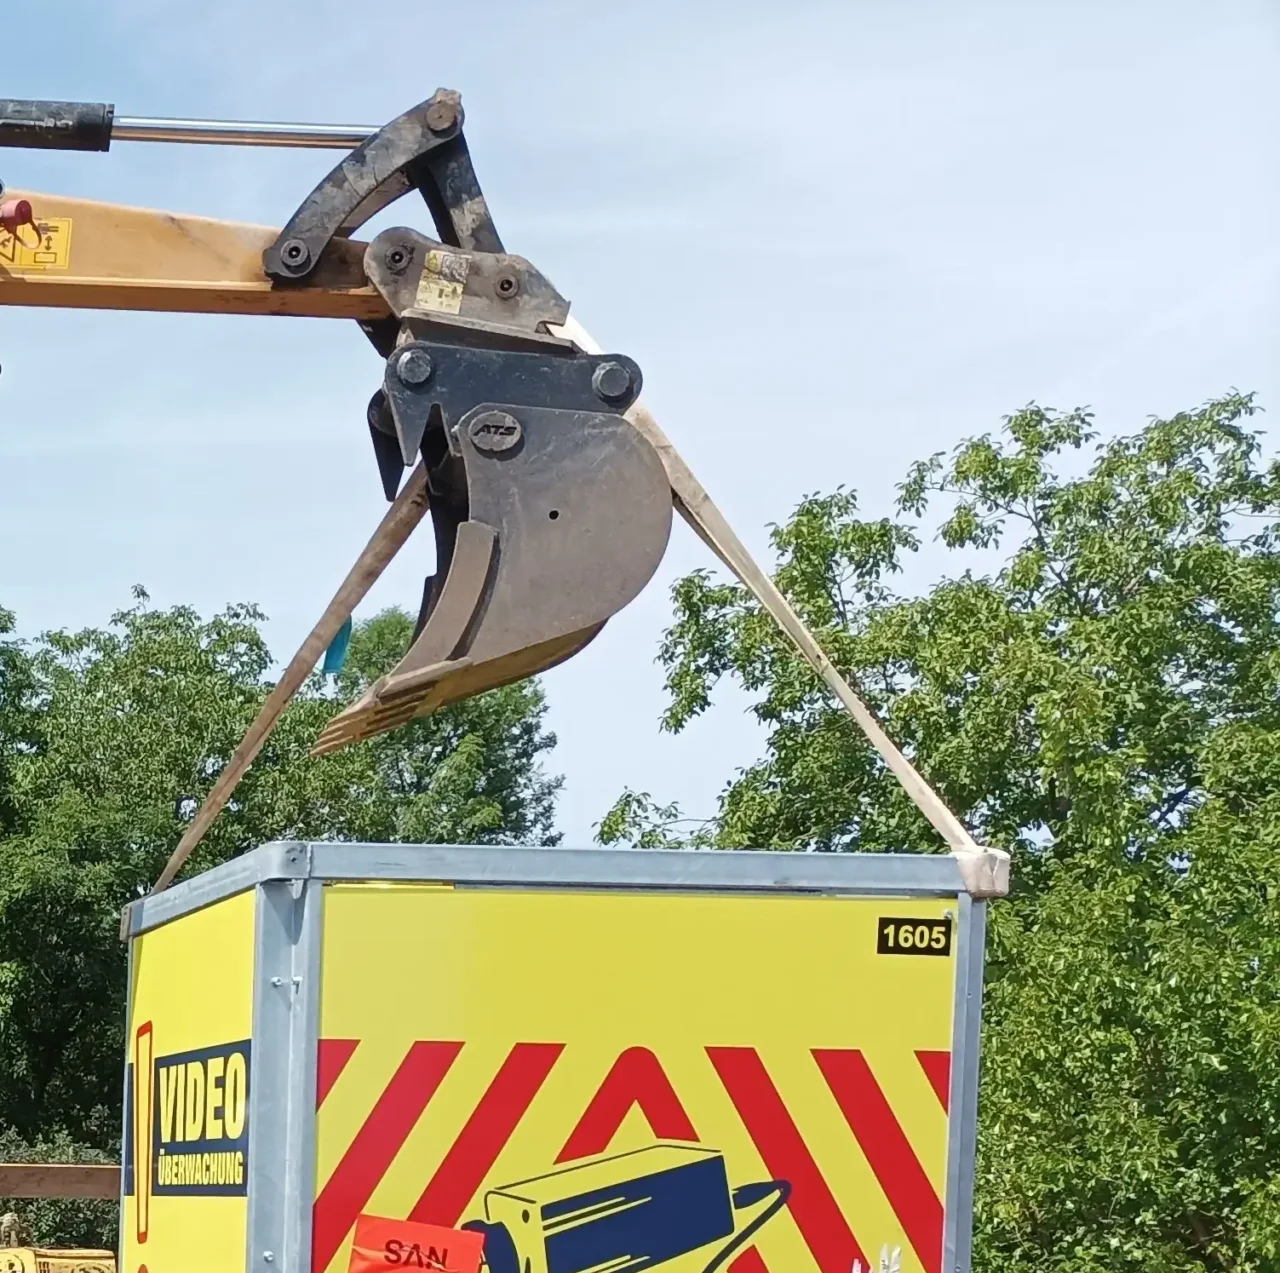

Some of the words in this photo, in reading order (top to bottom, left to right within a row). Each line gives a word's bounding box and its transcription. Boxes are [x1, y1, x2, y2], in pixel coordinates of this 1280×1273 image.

[884, 924, 946, 949] 1605
[159, 1052, 246, 1143] VIDEO
[158, 1148, 243, 1185] ÜBERWACHUNG
